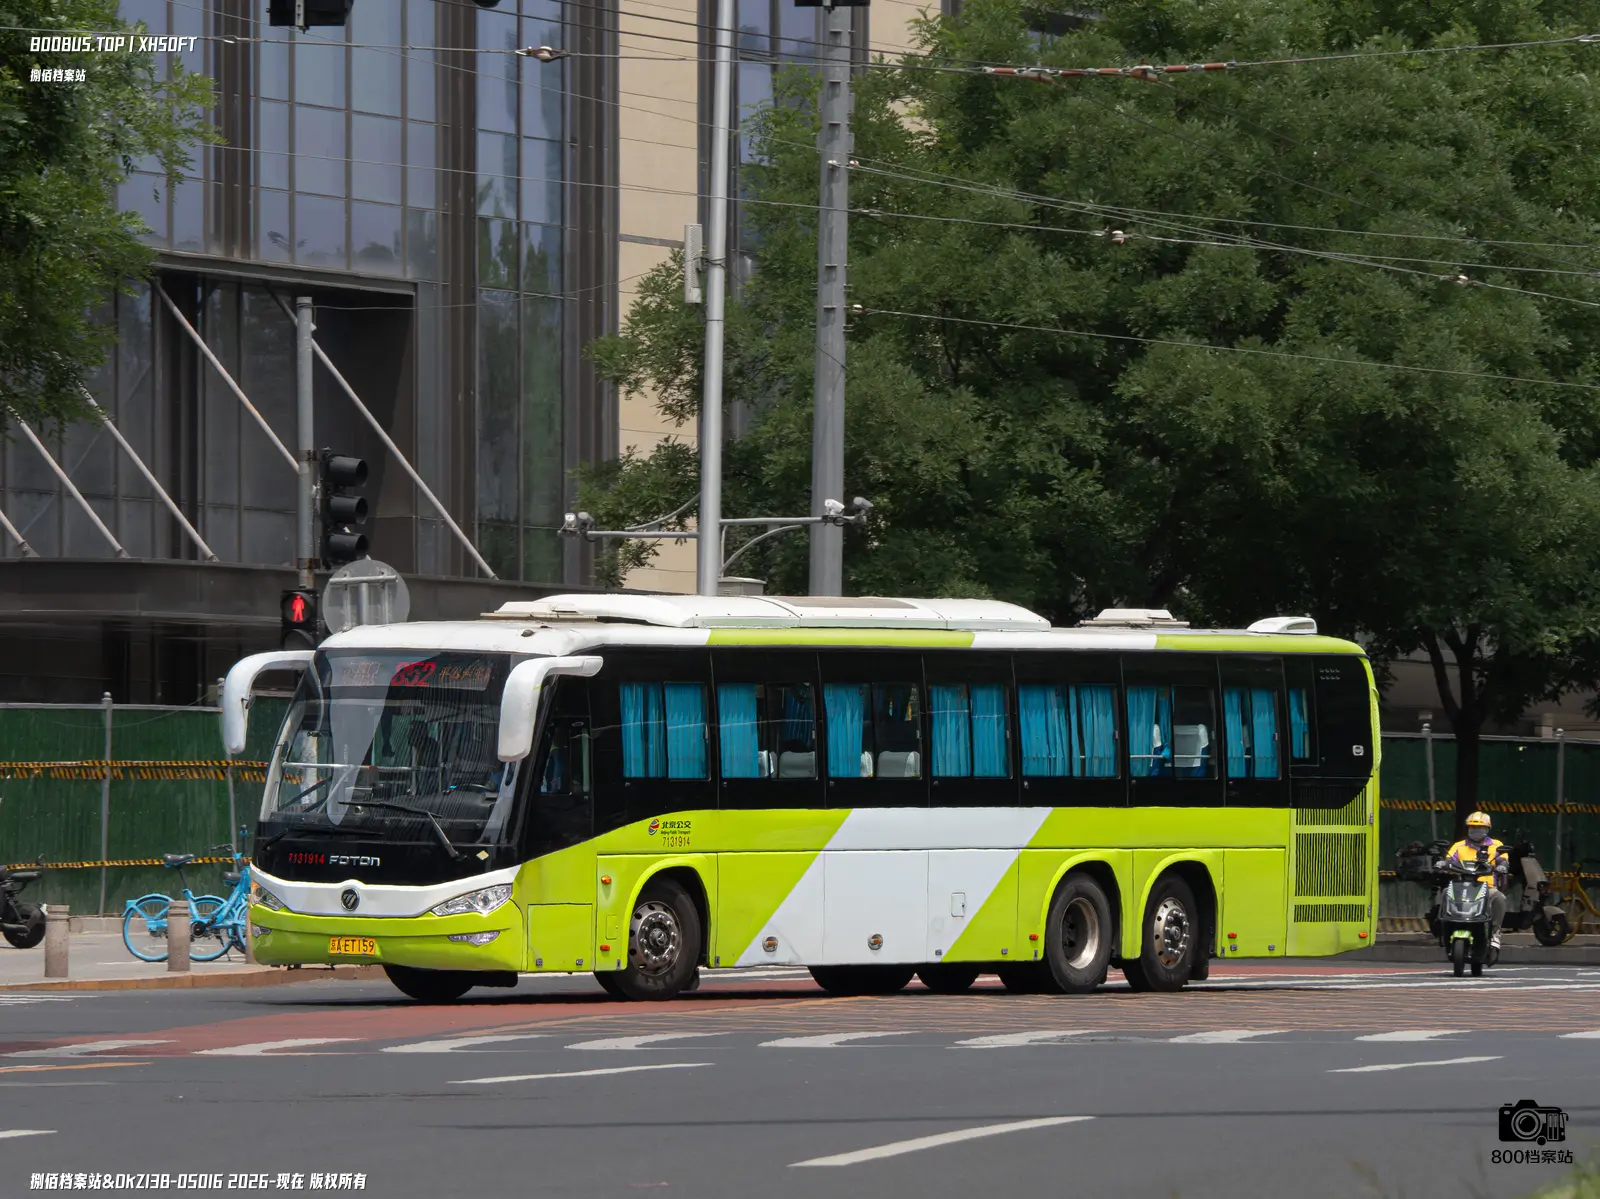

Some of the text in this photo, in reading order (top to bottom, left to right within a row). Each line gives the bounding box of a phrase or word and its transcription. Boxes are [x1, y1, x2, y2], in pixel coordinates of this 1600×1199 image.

[391, 661, 437, 687] 852
[661, 820, 692, 829] 北京公交
[663, 836, 690, 847] 7131914
[288, 853, 325, 864] 7131914
[329, 855, 380, 866] FOTON
